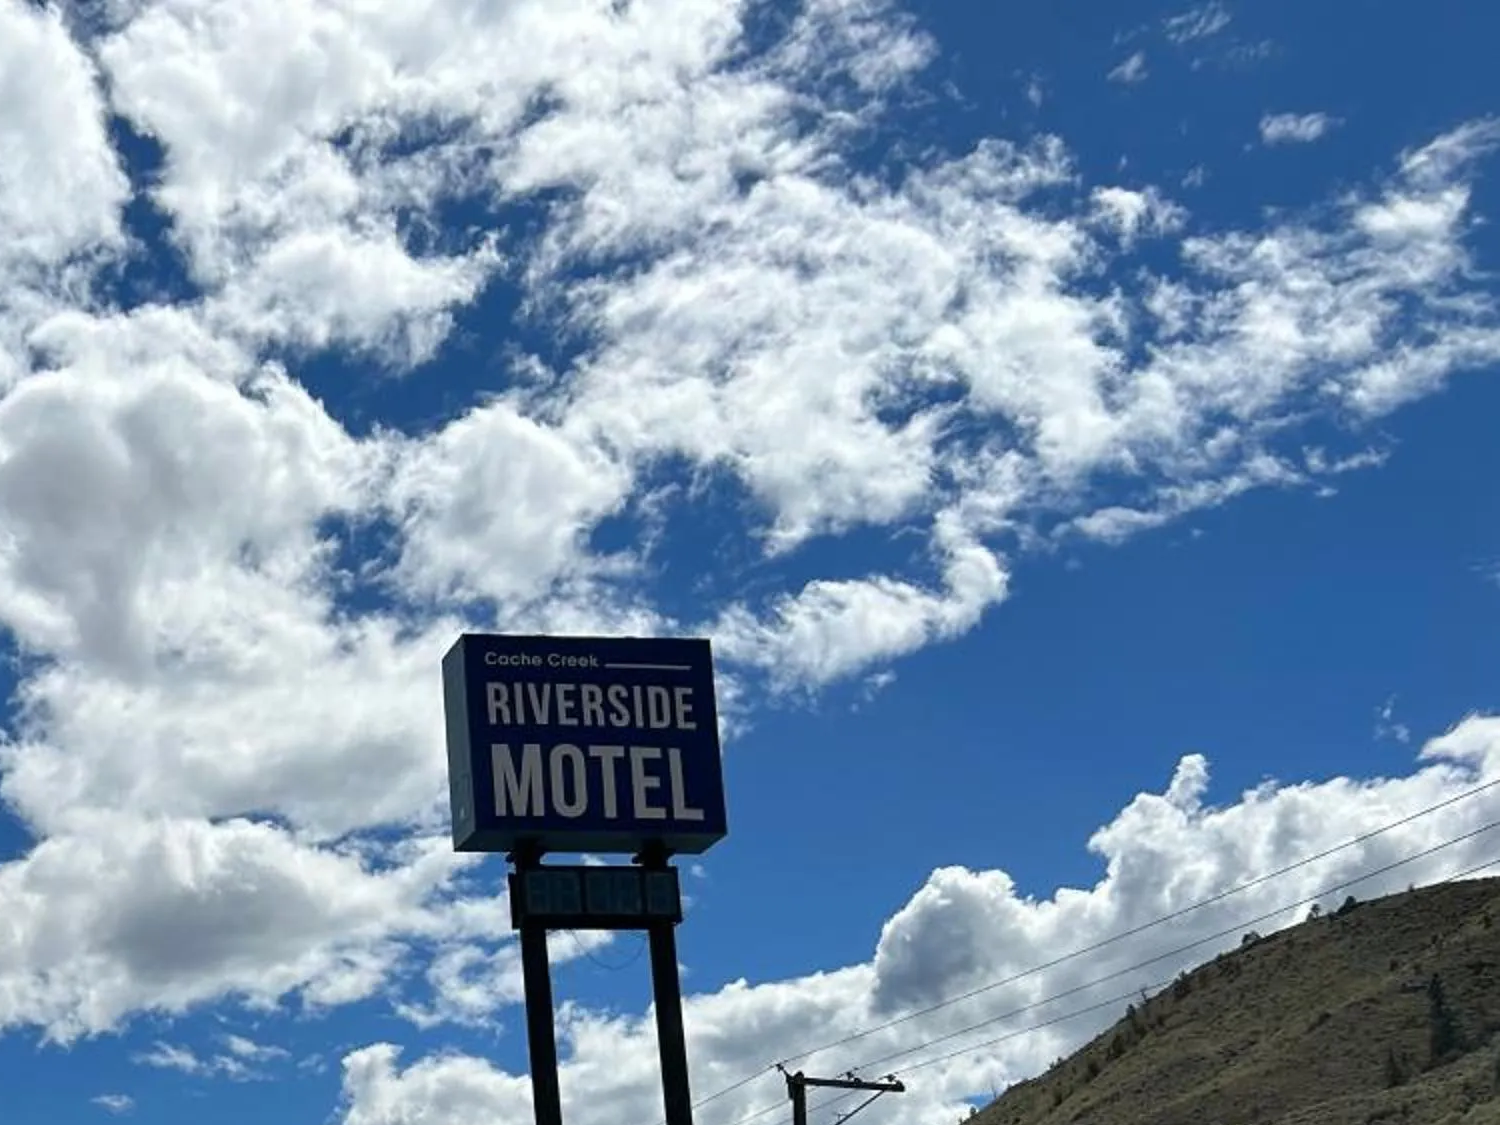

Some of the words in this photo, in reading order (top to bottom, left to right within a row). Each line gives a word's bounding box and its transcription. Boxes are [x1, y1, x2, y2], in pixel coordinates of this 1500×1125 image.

[484, 651, 542, 667] Cache
[547, 653, 598, 668] Creek
[486, 681, 697, 730] RIVERSIDE
[491, 743, 705, 821] MOTEL
